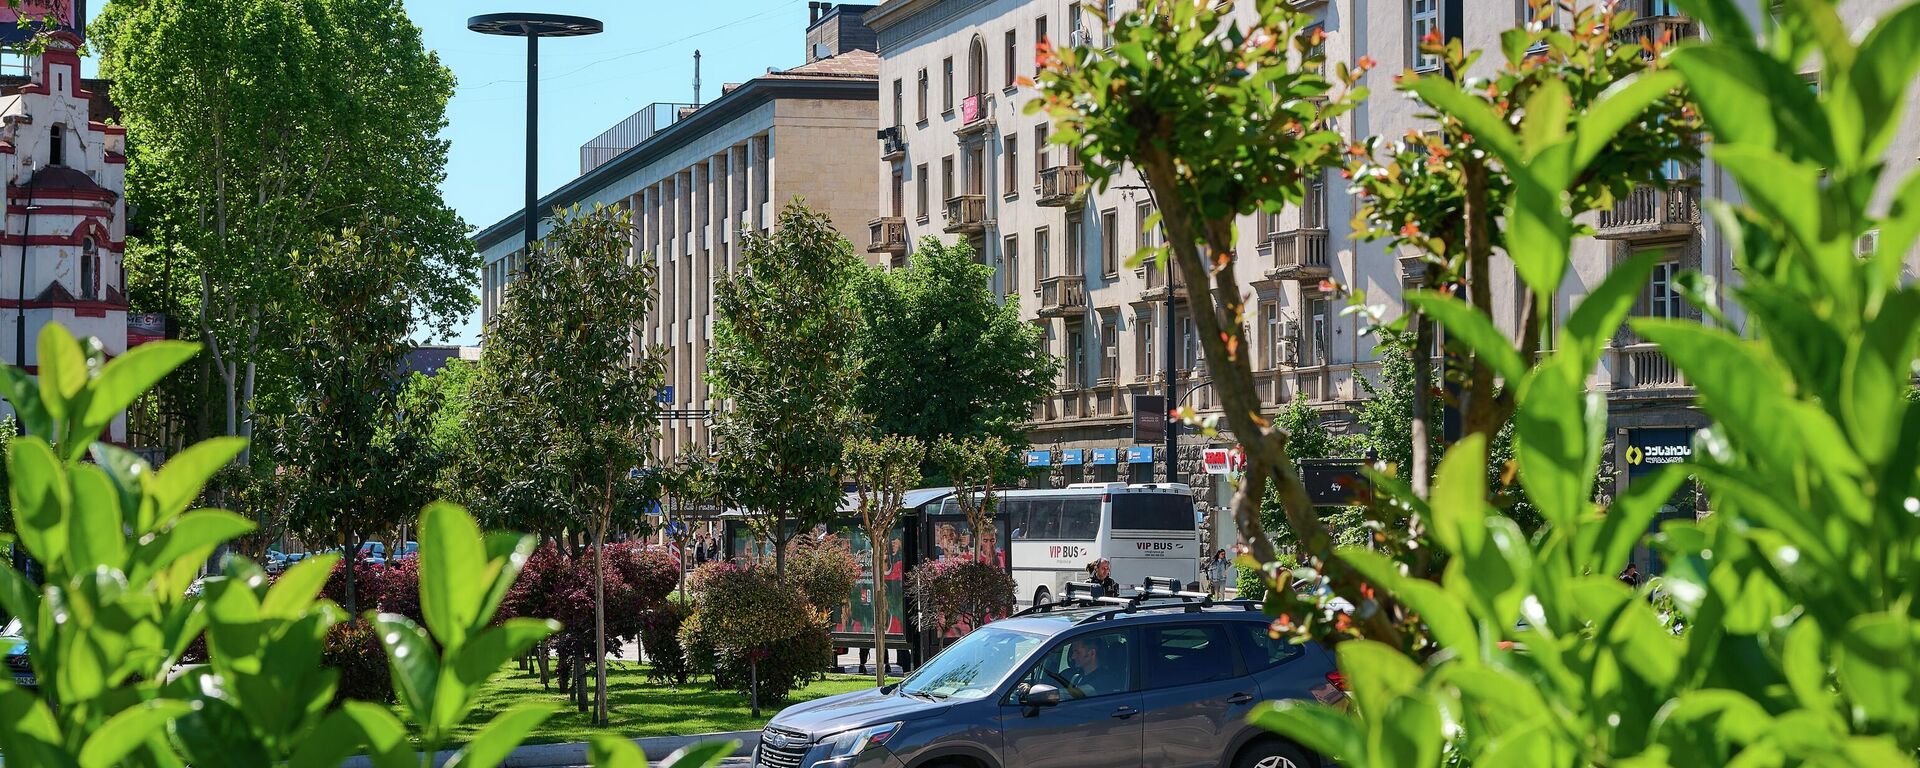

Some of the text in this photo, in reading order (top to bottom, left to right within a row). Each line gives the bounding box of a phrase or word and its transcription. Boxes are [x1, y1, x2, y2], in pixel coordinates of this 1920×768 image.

[1137, 542, 1173, 550] VIP BUS
[1049, 546, 1079, 558] VIP BUS
